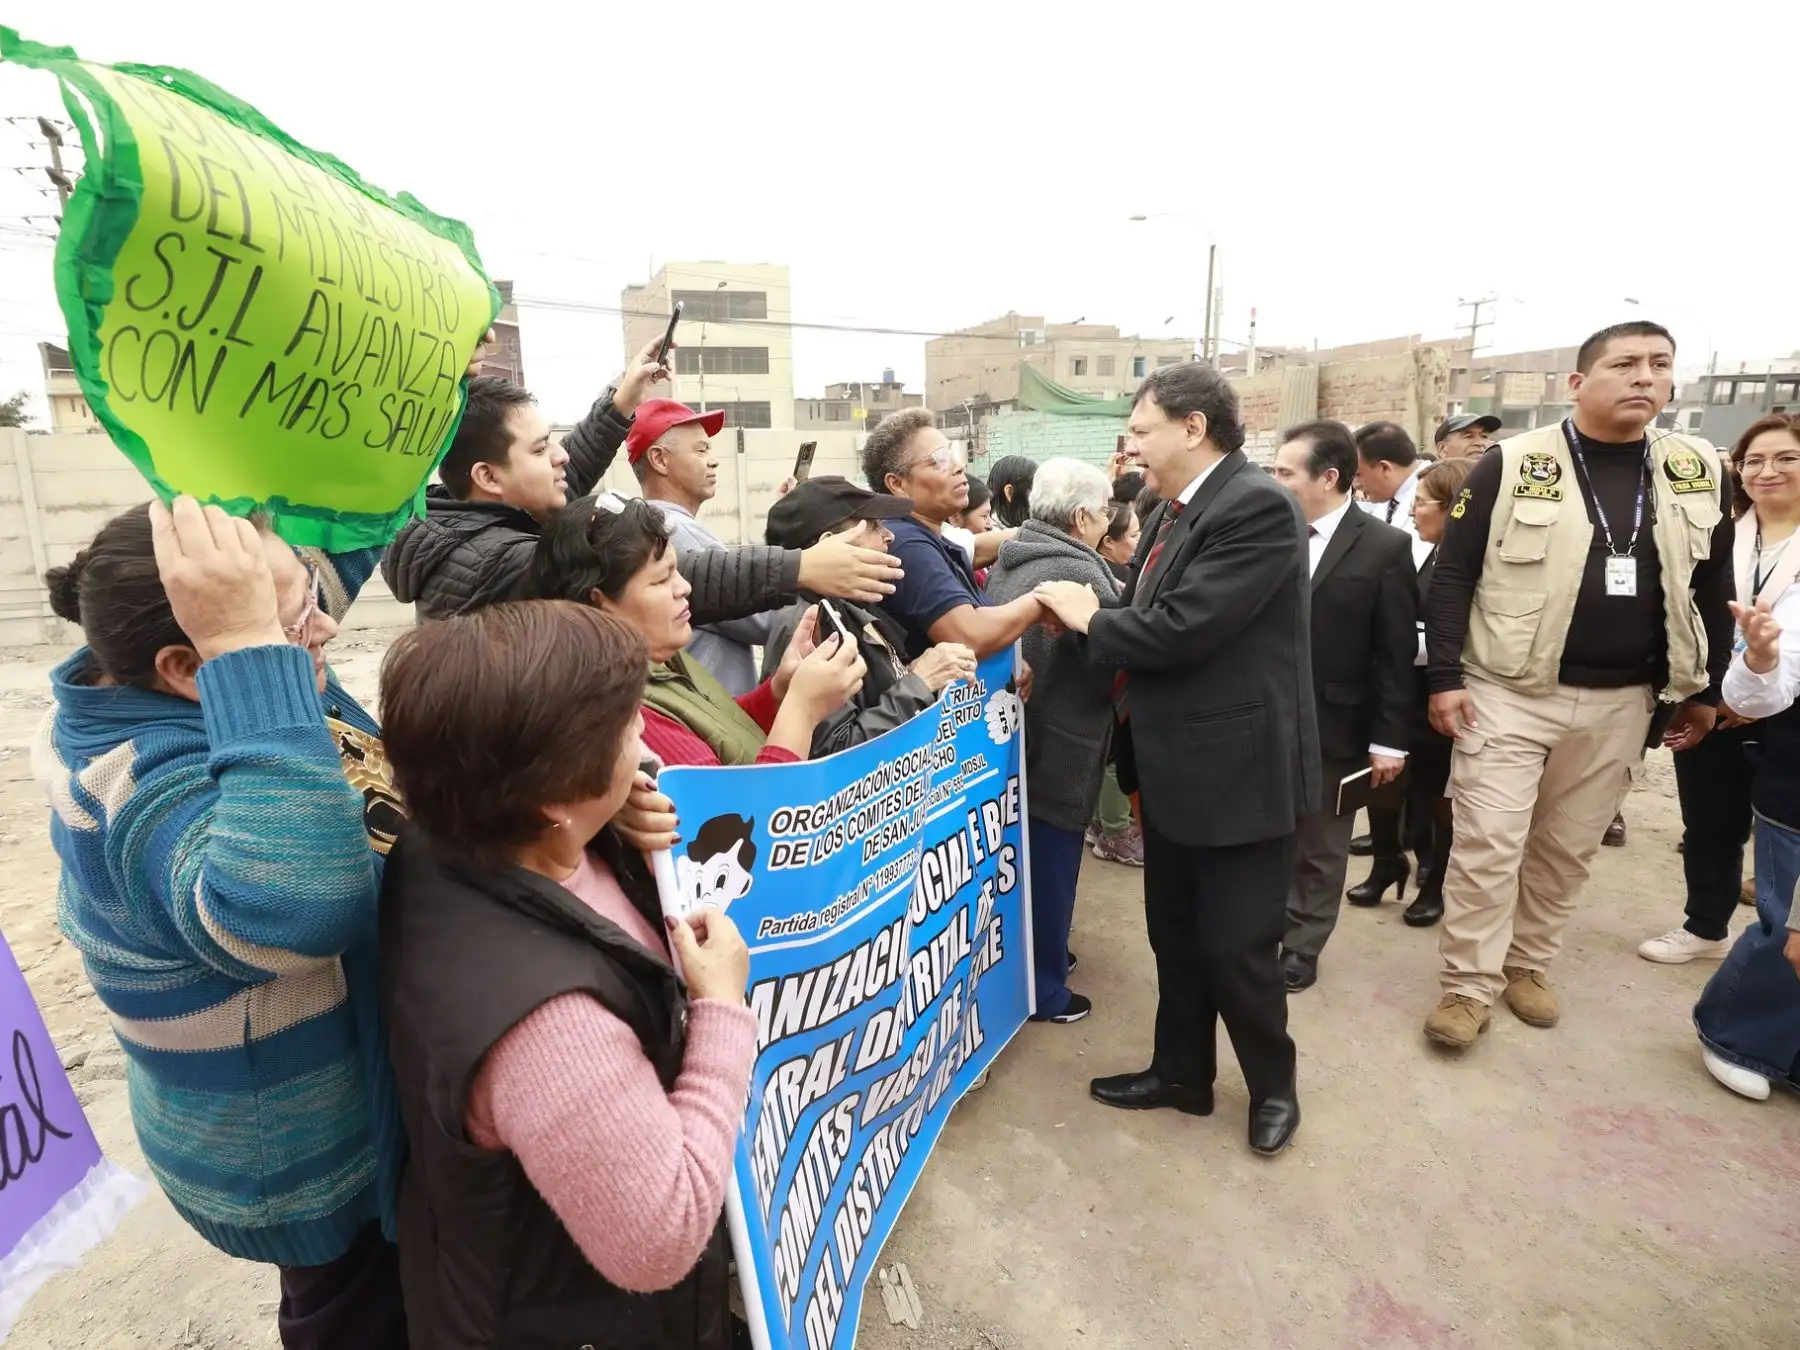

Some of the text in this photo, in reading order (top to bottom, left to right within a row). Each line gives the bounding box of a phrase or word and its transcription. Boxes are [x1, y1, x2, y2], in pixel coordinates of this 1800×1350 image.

[160, 135, 460, 333] DEL MINISTRO
[108, 325, 228, 414] CON
[284, 289, 457, 404] AVANZA
[770, 842, 810, 868] DE
[813, 824, 843, 863] LOS
[847, 791, 902, 842] COMITES
[904, 778, 925, 807] DEL
[954, 702, 981, 725] RITO
[770, 764, 891, 835] ORGANIZACIÓN
[893, 748, 931, 782] SOCIAL
[863, 833, 881, 863] DE
[882, 815, 909, 849] SAN
[759, 914, 817, 938] Partida
[819, 888, 860, 925] registral
[745, 917, 908, 1056] ANIZACI
[753, 1028, 856, 1227] ENTRAL
[860, 1018, 938, 1130] VASO
[834, 1082, 931, 1292] DISTRITO
